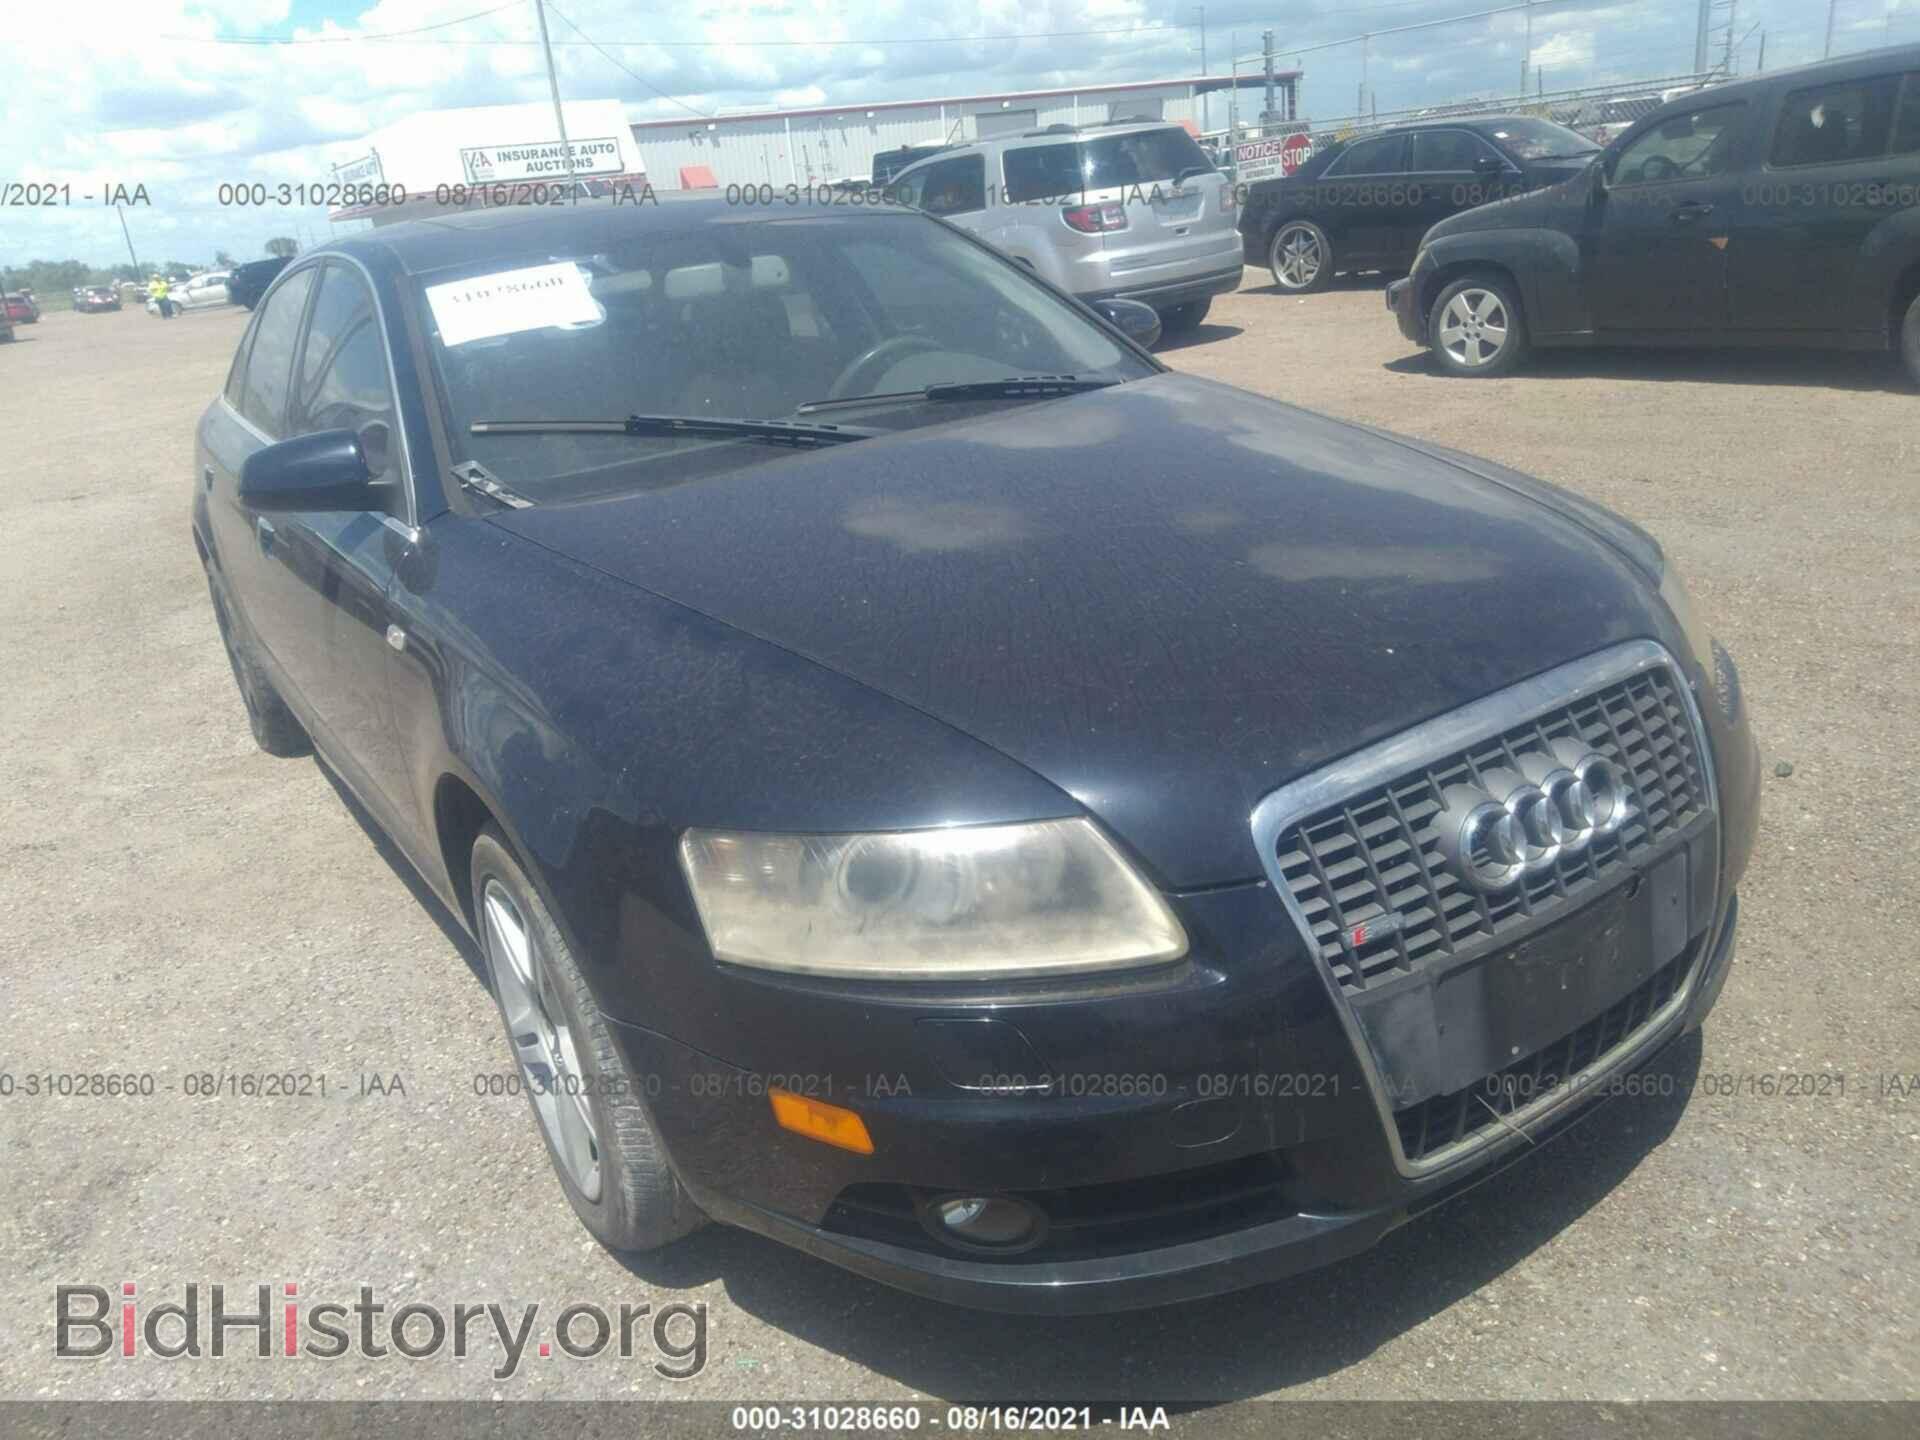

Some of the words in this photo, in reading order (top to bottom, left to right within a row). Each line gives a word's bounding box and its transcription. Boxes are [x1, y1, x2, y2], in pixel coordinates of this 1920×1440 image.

[581, 143, 615, 156] AUTO
[1238, 143, 1279, 160] NOTICE
[1283, 147, 1311, 167] STOP
